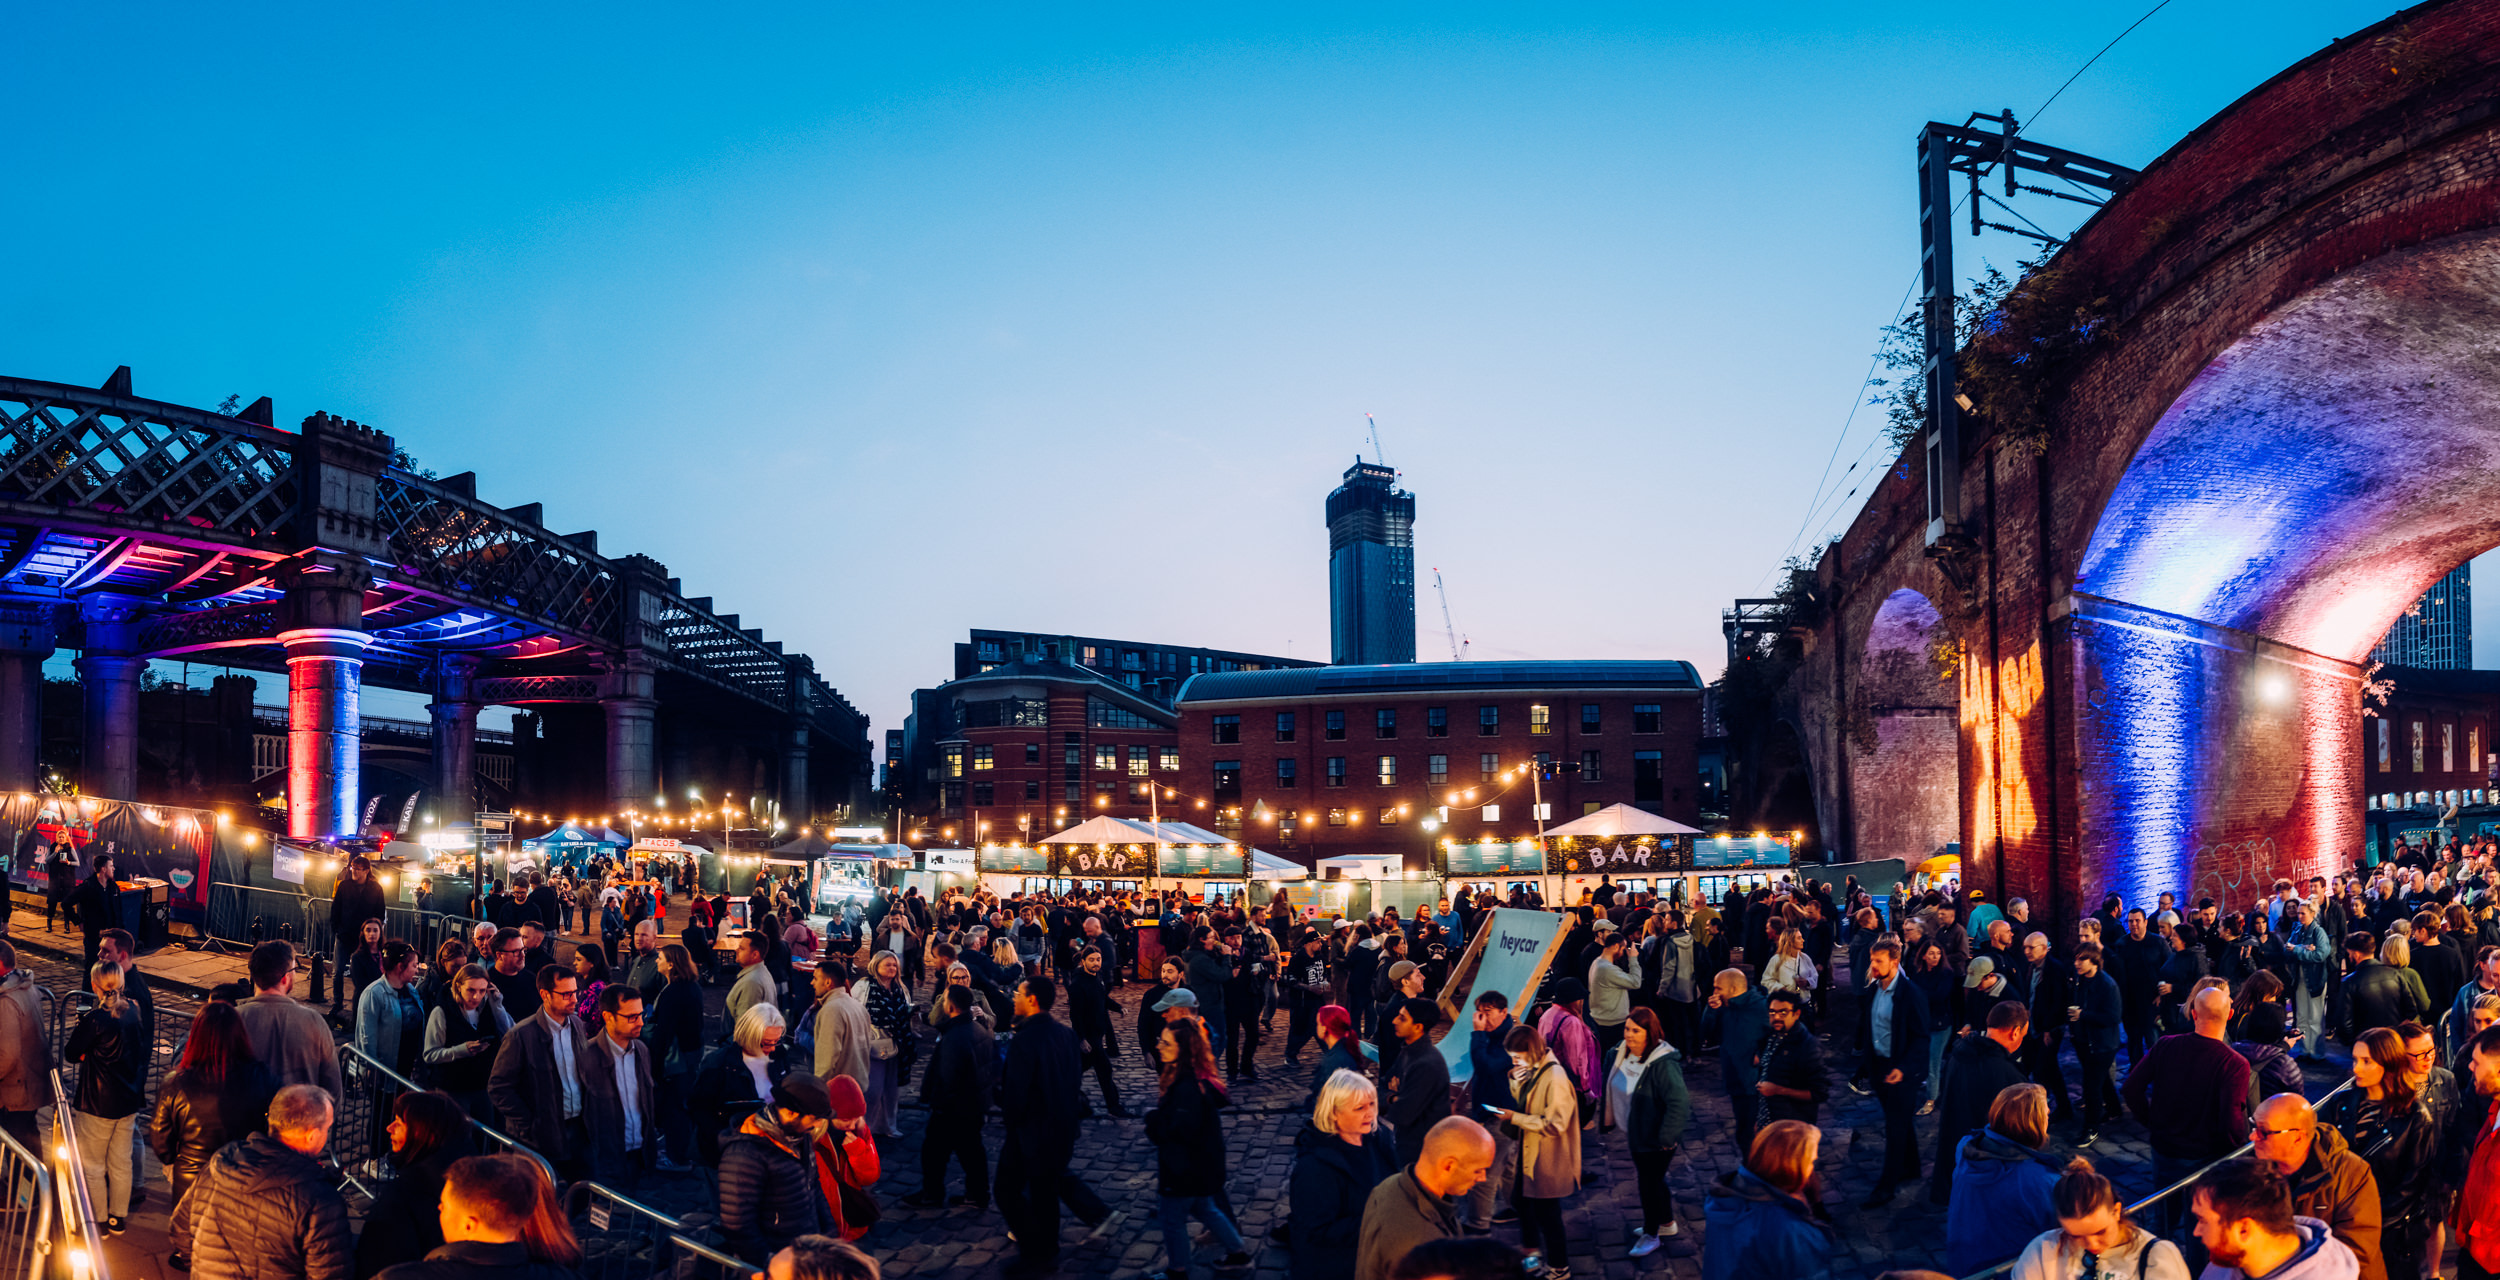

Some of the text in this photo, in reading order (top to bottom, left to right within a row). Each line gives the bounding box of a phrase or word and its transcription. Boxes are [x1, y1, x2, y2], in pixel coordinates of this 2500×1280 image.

[364, 795, 379, 826] GYOZA
[402, 794, 417, 822] KATSU
[644, 838, 675, 847] TACOS
[1589, 843, 1651, 868] BAR
[1078, 852, 1126, 872] BAR
[1499, 930, 1539, 957] heycar
